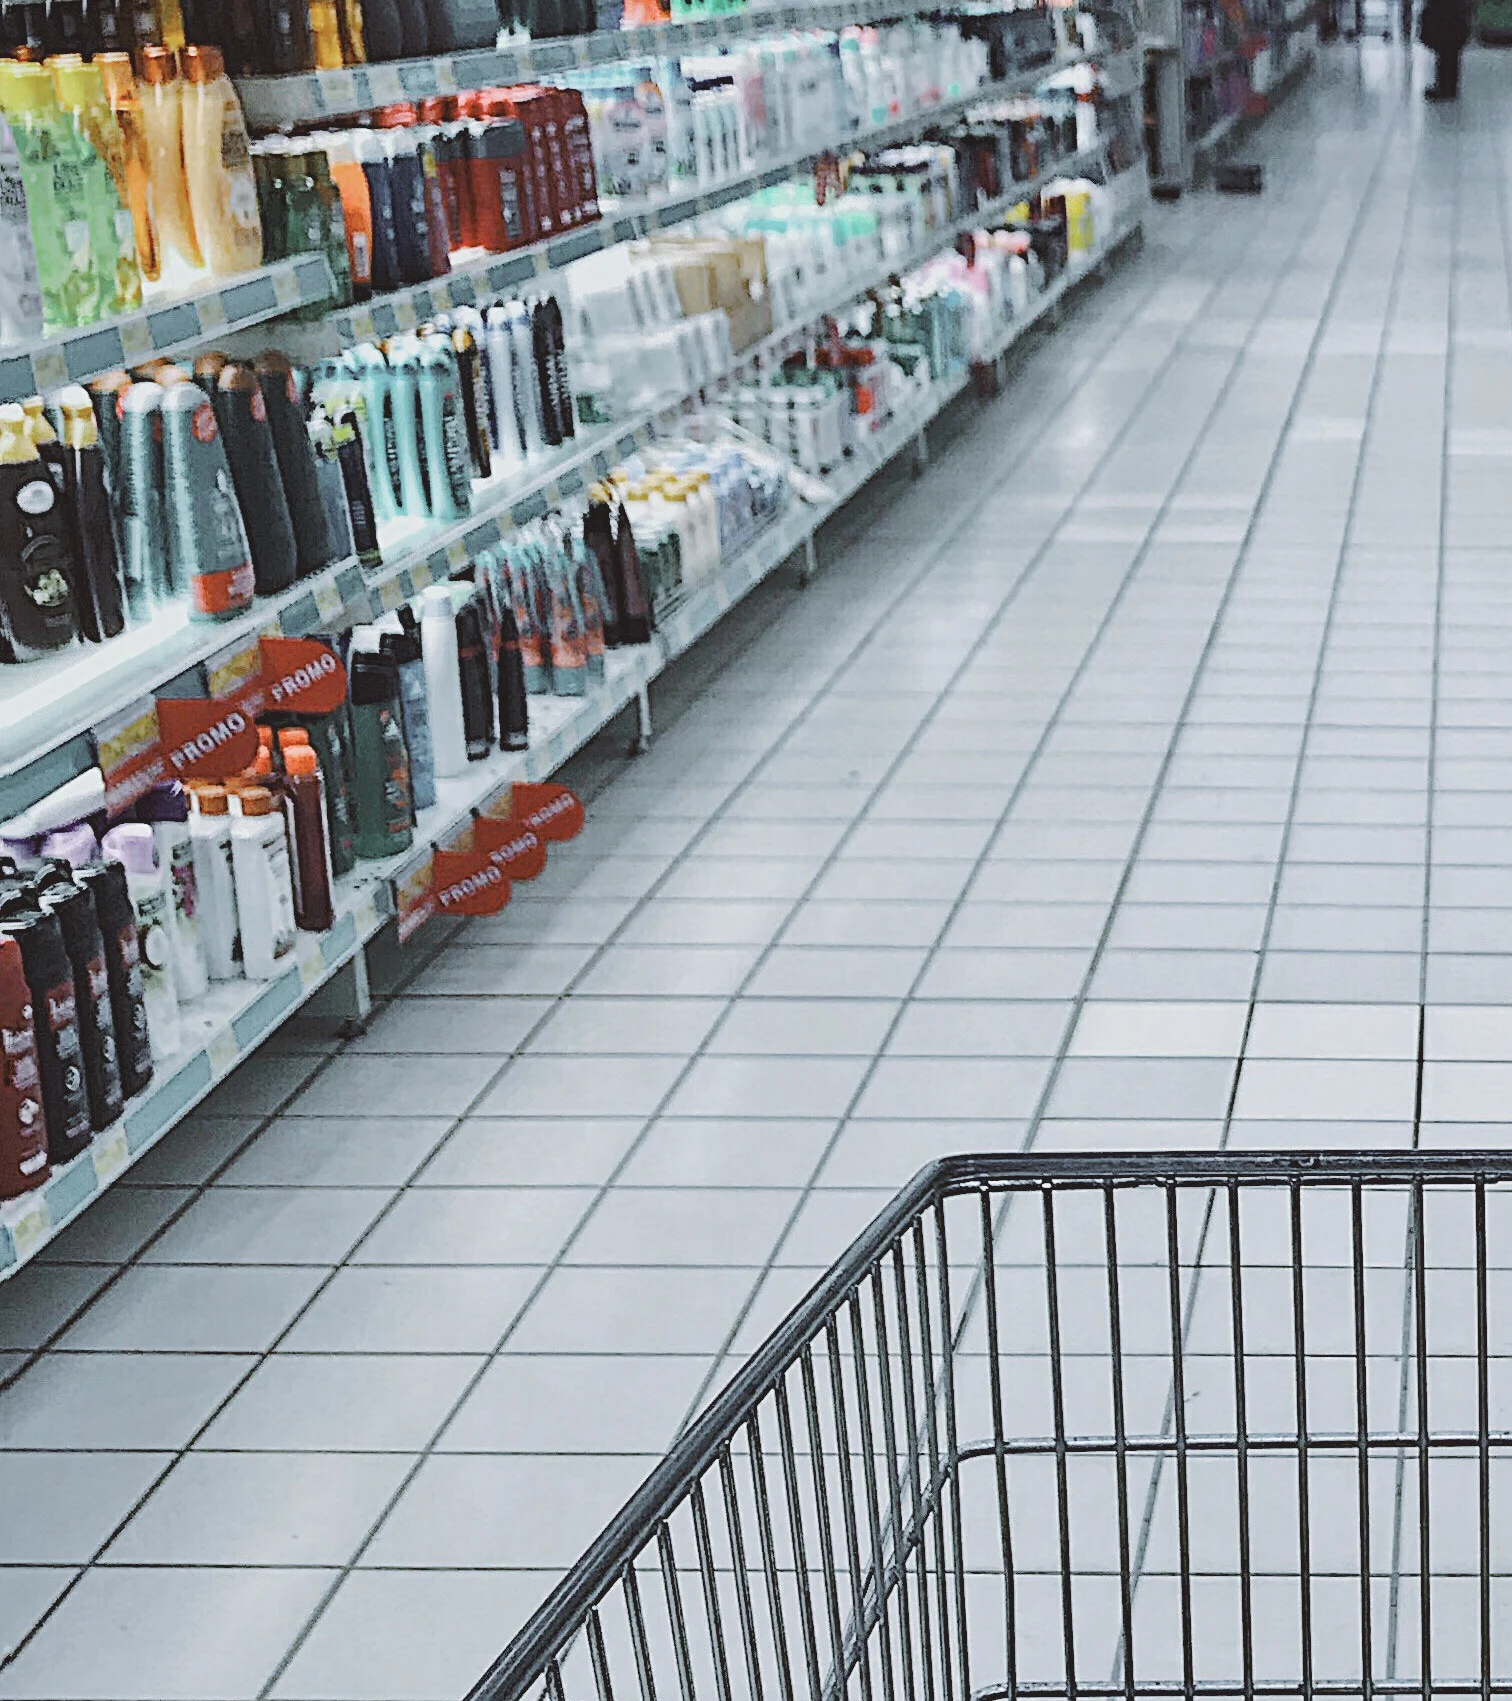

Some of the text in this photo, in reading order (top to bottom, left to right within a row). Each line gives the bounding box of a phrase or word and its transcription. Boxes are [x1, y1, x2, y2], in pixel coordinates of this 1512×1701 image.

[270, 653, 337, 702] PROMO
[170, 712, 246, 771] PROMO
[523, 793, 575, 827] ROMO
[489, 832, 538, 865] ROMO
[439, 866, 501, 907] PROMO
